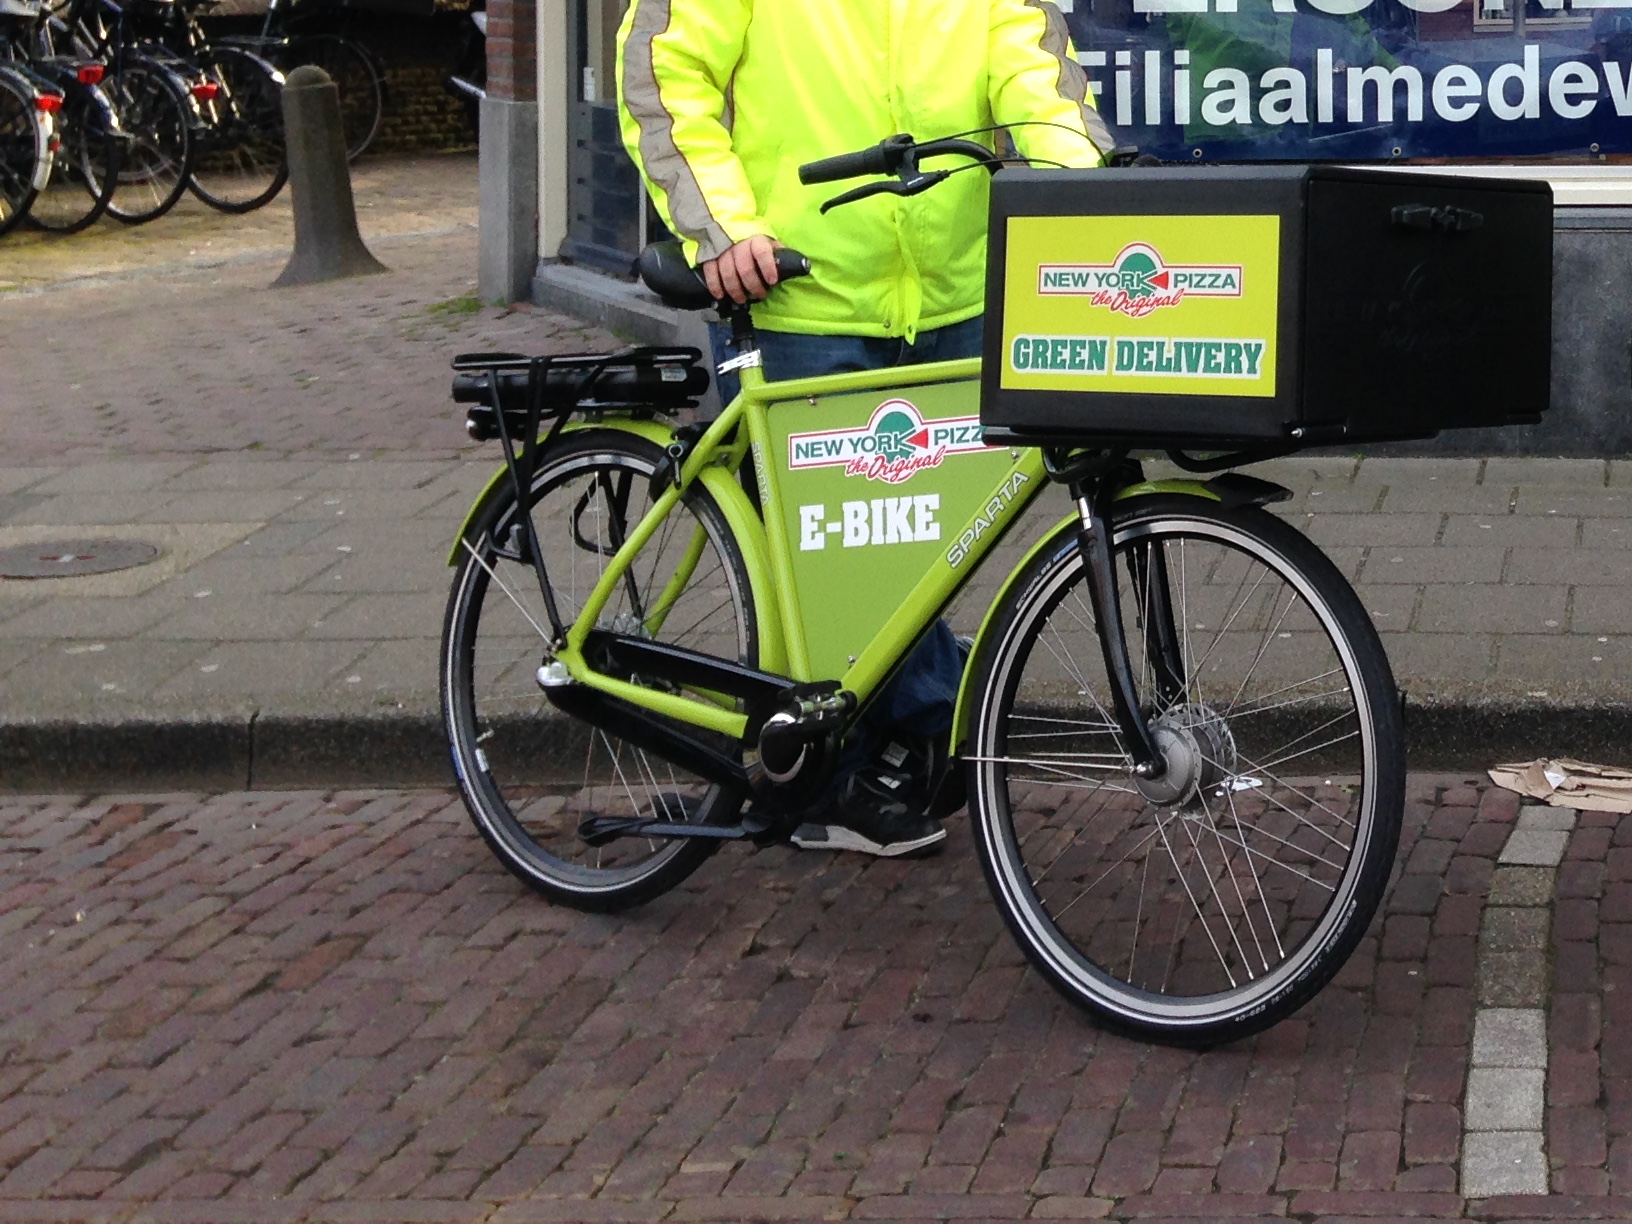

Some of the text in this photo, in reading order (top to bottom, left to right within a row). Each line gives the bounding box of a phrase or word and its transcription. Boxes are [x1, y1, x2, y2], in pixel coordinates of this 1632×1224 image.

[1043, 269, 1236, 292] NEW YORK PIZZA
[1090, 287, 1184, 316] the Original
[1013, 337, 1263, 375] GREEN DELIVERY
[795, 425, 985, 460] NEW YORK PIZZ
[846, 445, 946, 482] the Original
[799, 493, 941, 552] E-BIKE
[946, 471, 1029, 568] SPARTA
